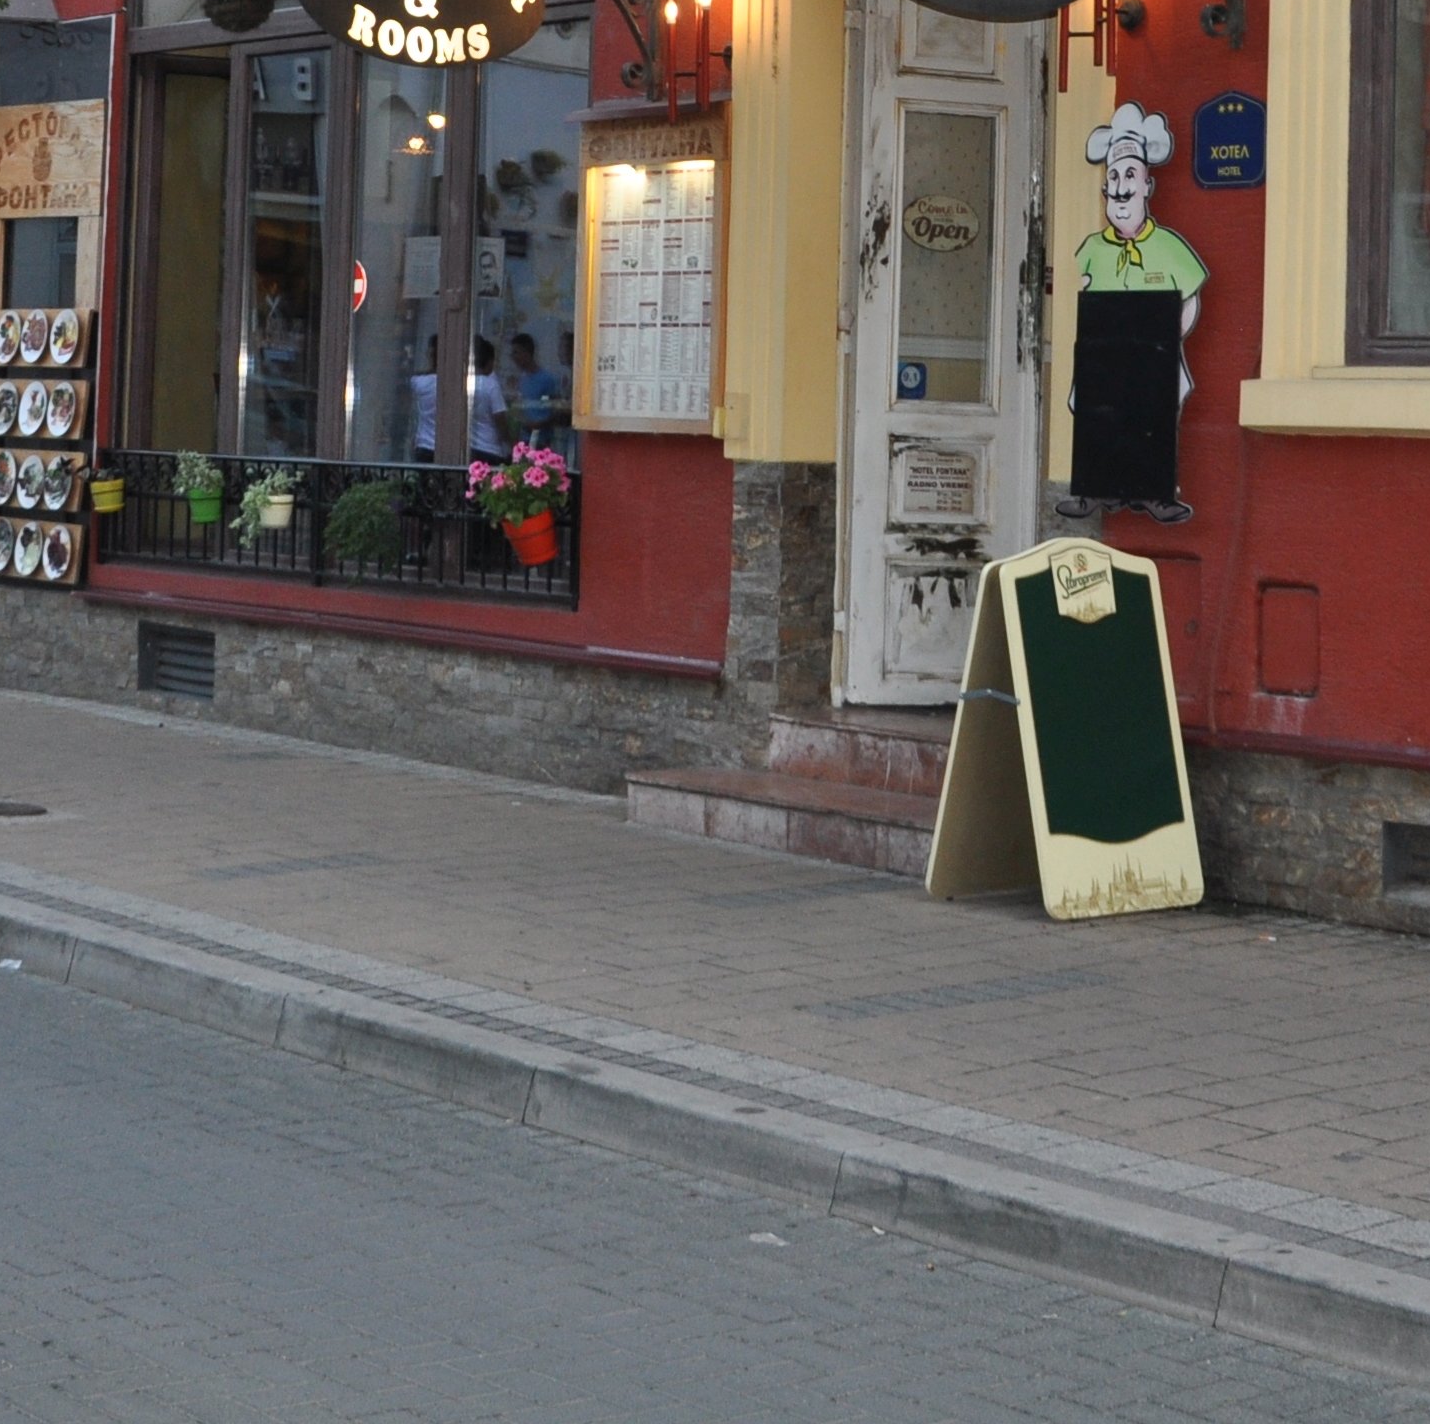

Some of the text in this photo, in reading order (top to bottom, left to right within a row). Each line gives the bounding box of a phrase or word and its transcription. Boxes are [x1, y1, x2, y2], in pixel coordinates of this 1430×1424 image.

[347, 3, 490, 64] ROOMS
[1210, 144, 1250, 160] ХОТЕЛ
[1217, 165, 1242, 176] HOTEL
[911, 216, 970, 243] Open
